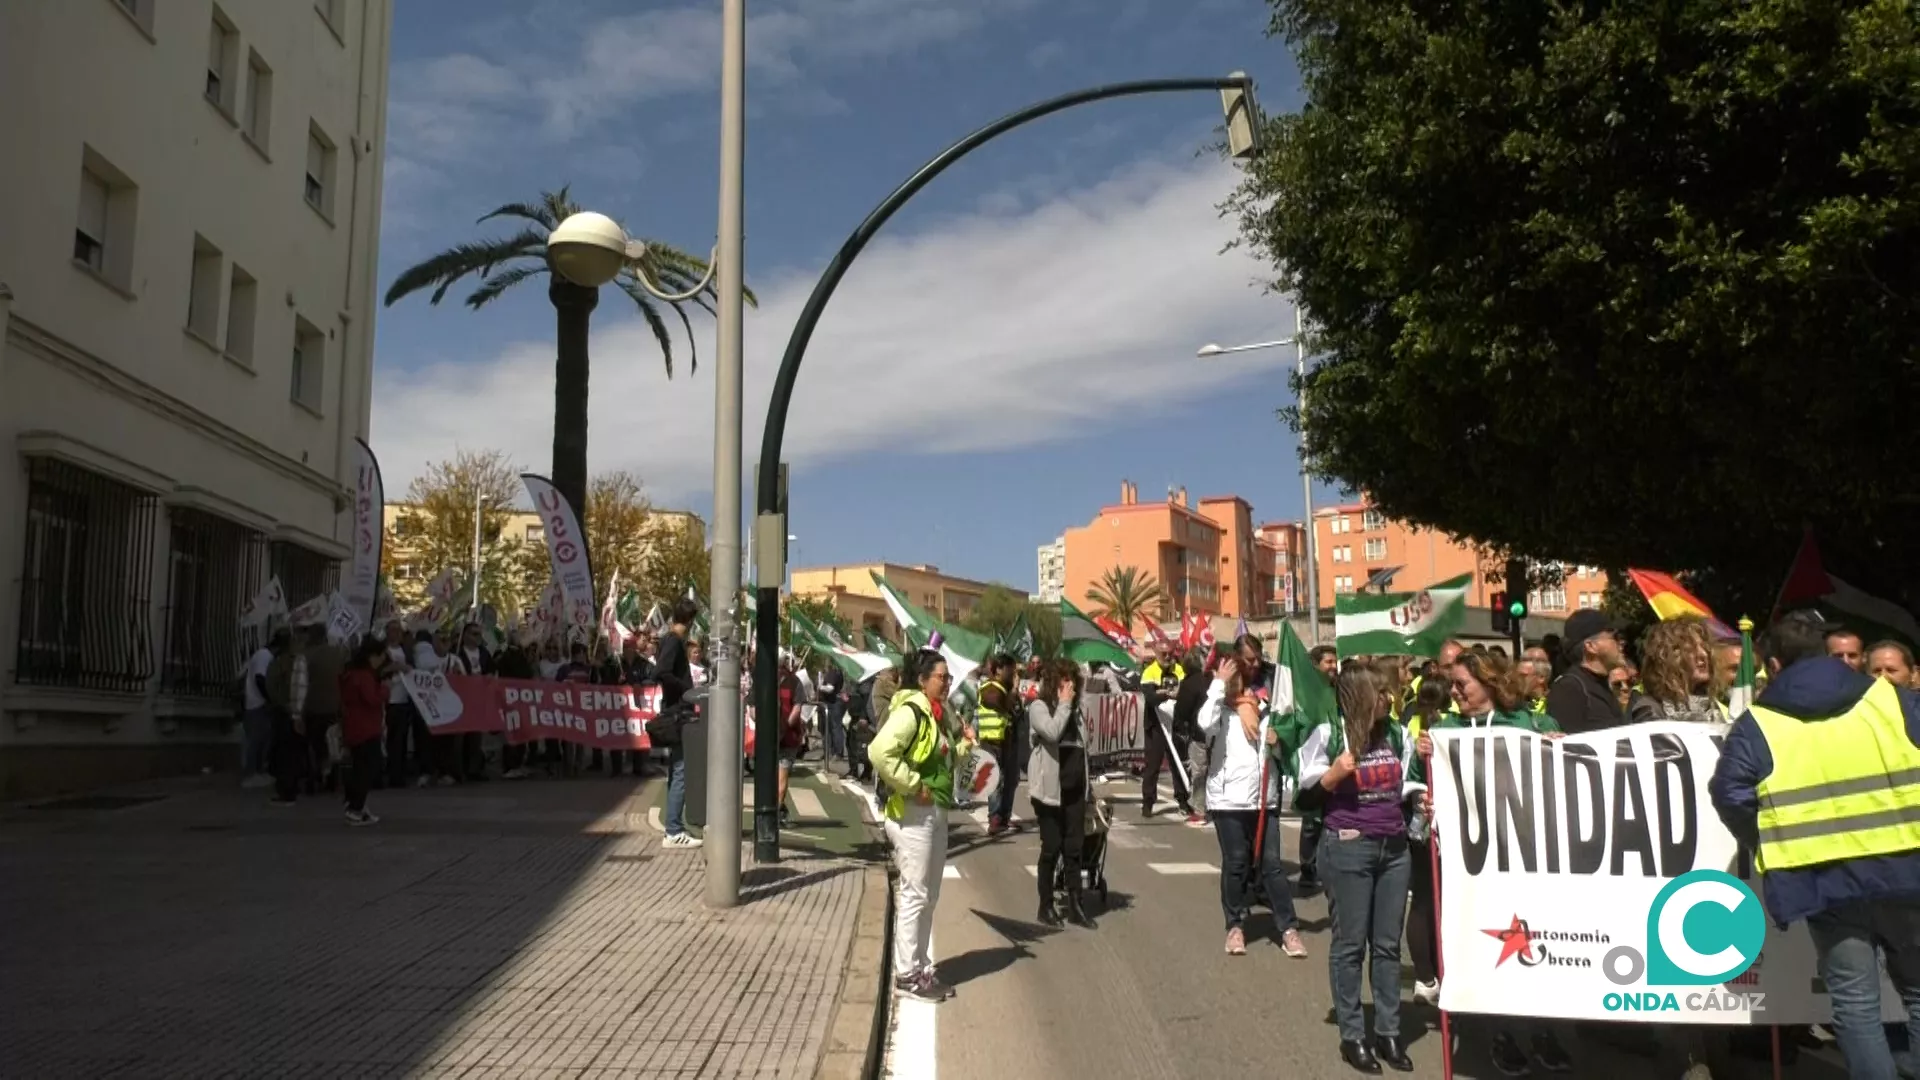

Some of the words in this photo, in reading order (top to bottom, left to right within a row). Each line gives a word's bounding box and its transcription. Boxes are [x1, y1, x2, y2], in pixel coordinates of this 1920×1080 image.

[1389, 591, 1433, 626] USO
[505, 687, 544, 704] por
[553, 689, 573, 706] el
[531, 706, 587, 732] letra
[1098, 693, 1138, 751] MAYO
[1448, 733, 1697, 878] UNIDAD
